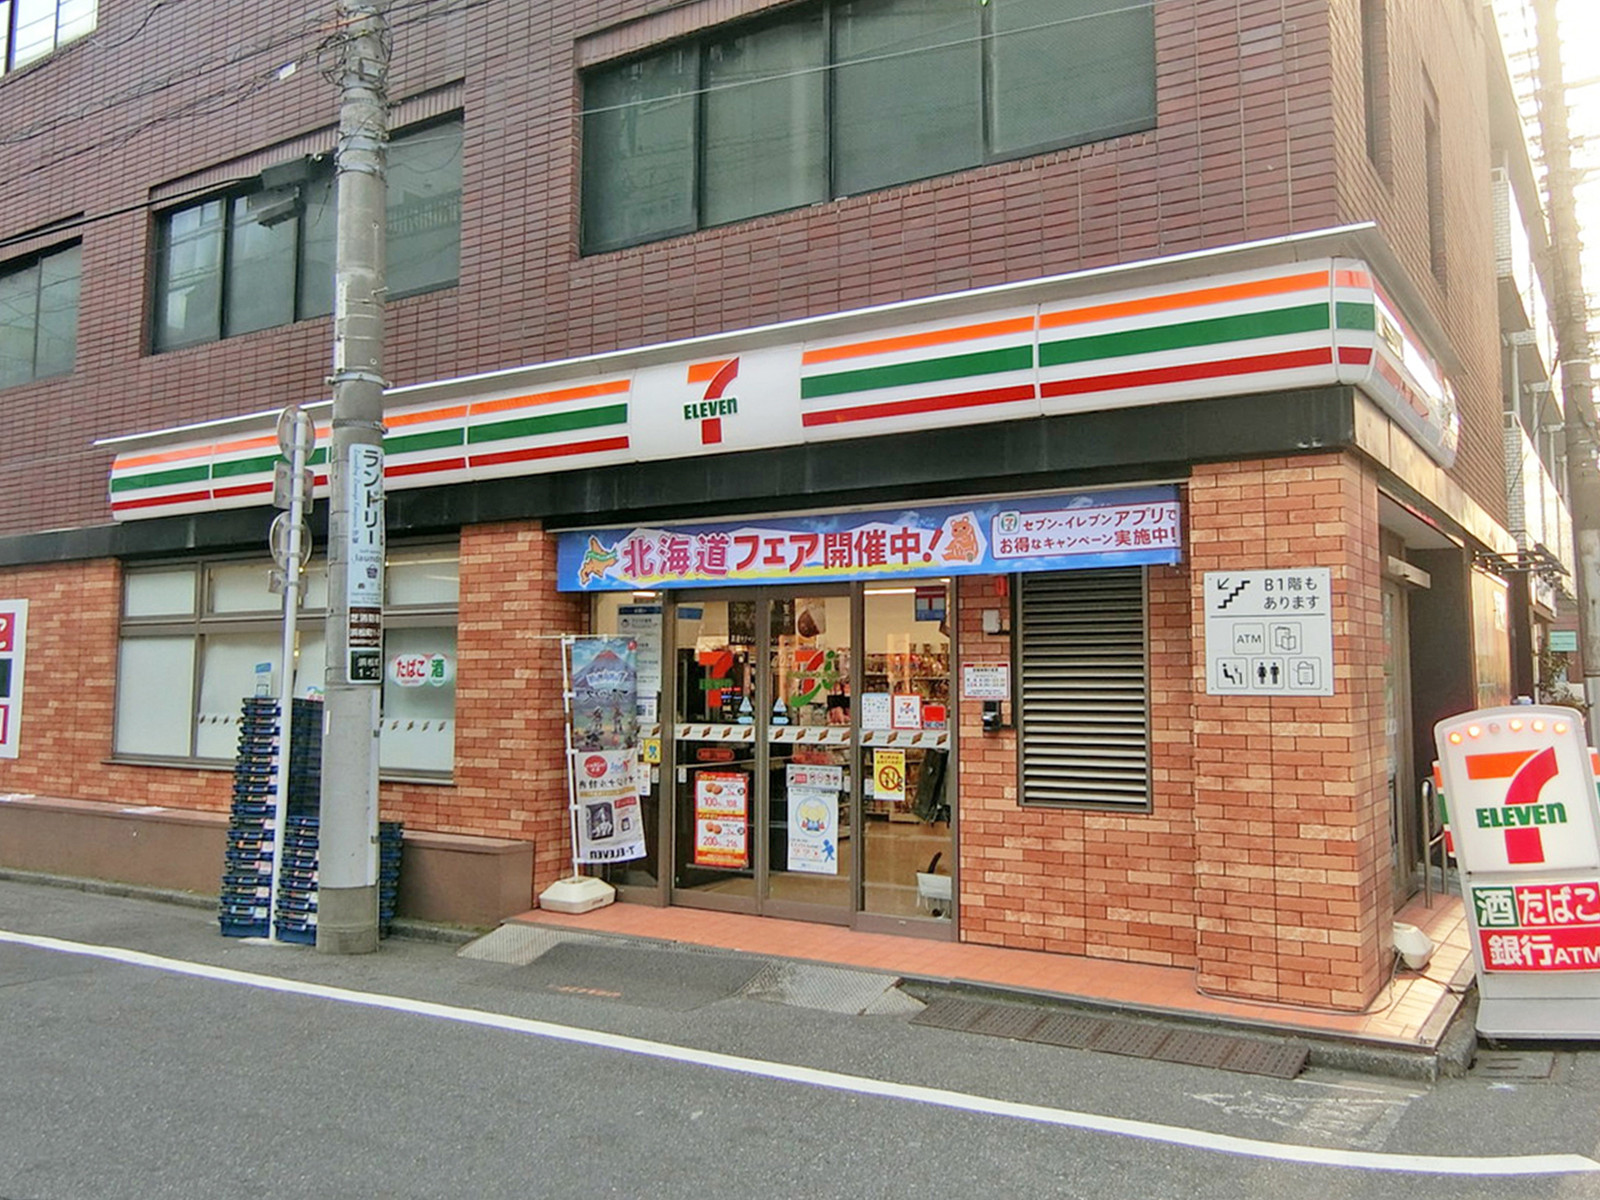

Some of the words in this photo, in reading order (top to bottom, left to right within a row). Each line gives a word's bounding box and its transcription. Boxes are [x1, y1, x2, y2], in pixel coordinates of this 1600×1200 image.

[687, 356, 740, 445] 7
[363, 450, 379, 544] ランドリー
[622, 528, 944, 578] 北海道フェア開催中!
[1000, 527, 1176, 554] お得なキャンペーン実施中!
[1264, 577, 1318, 592] B1階も
[1263, 595, 1320, 610] あります
[1236, 634, 1262, 643] ATM
[396, 659, 426, 678] たばこ
[431, 659, 445, 678] 酒
[1465, 746, 1559, 864] 7
[1476, 889, 1517, 927] 酒
[1519, 885, 1600, 926] たばこ
